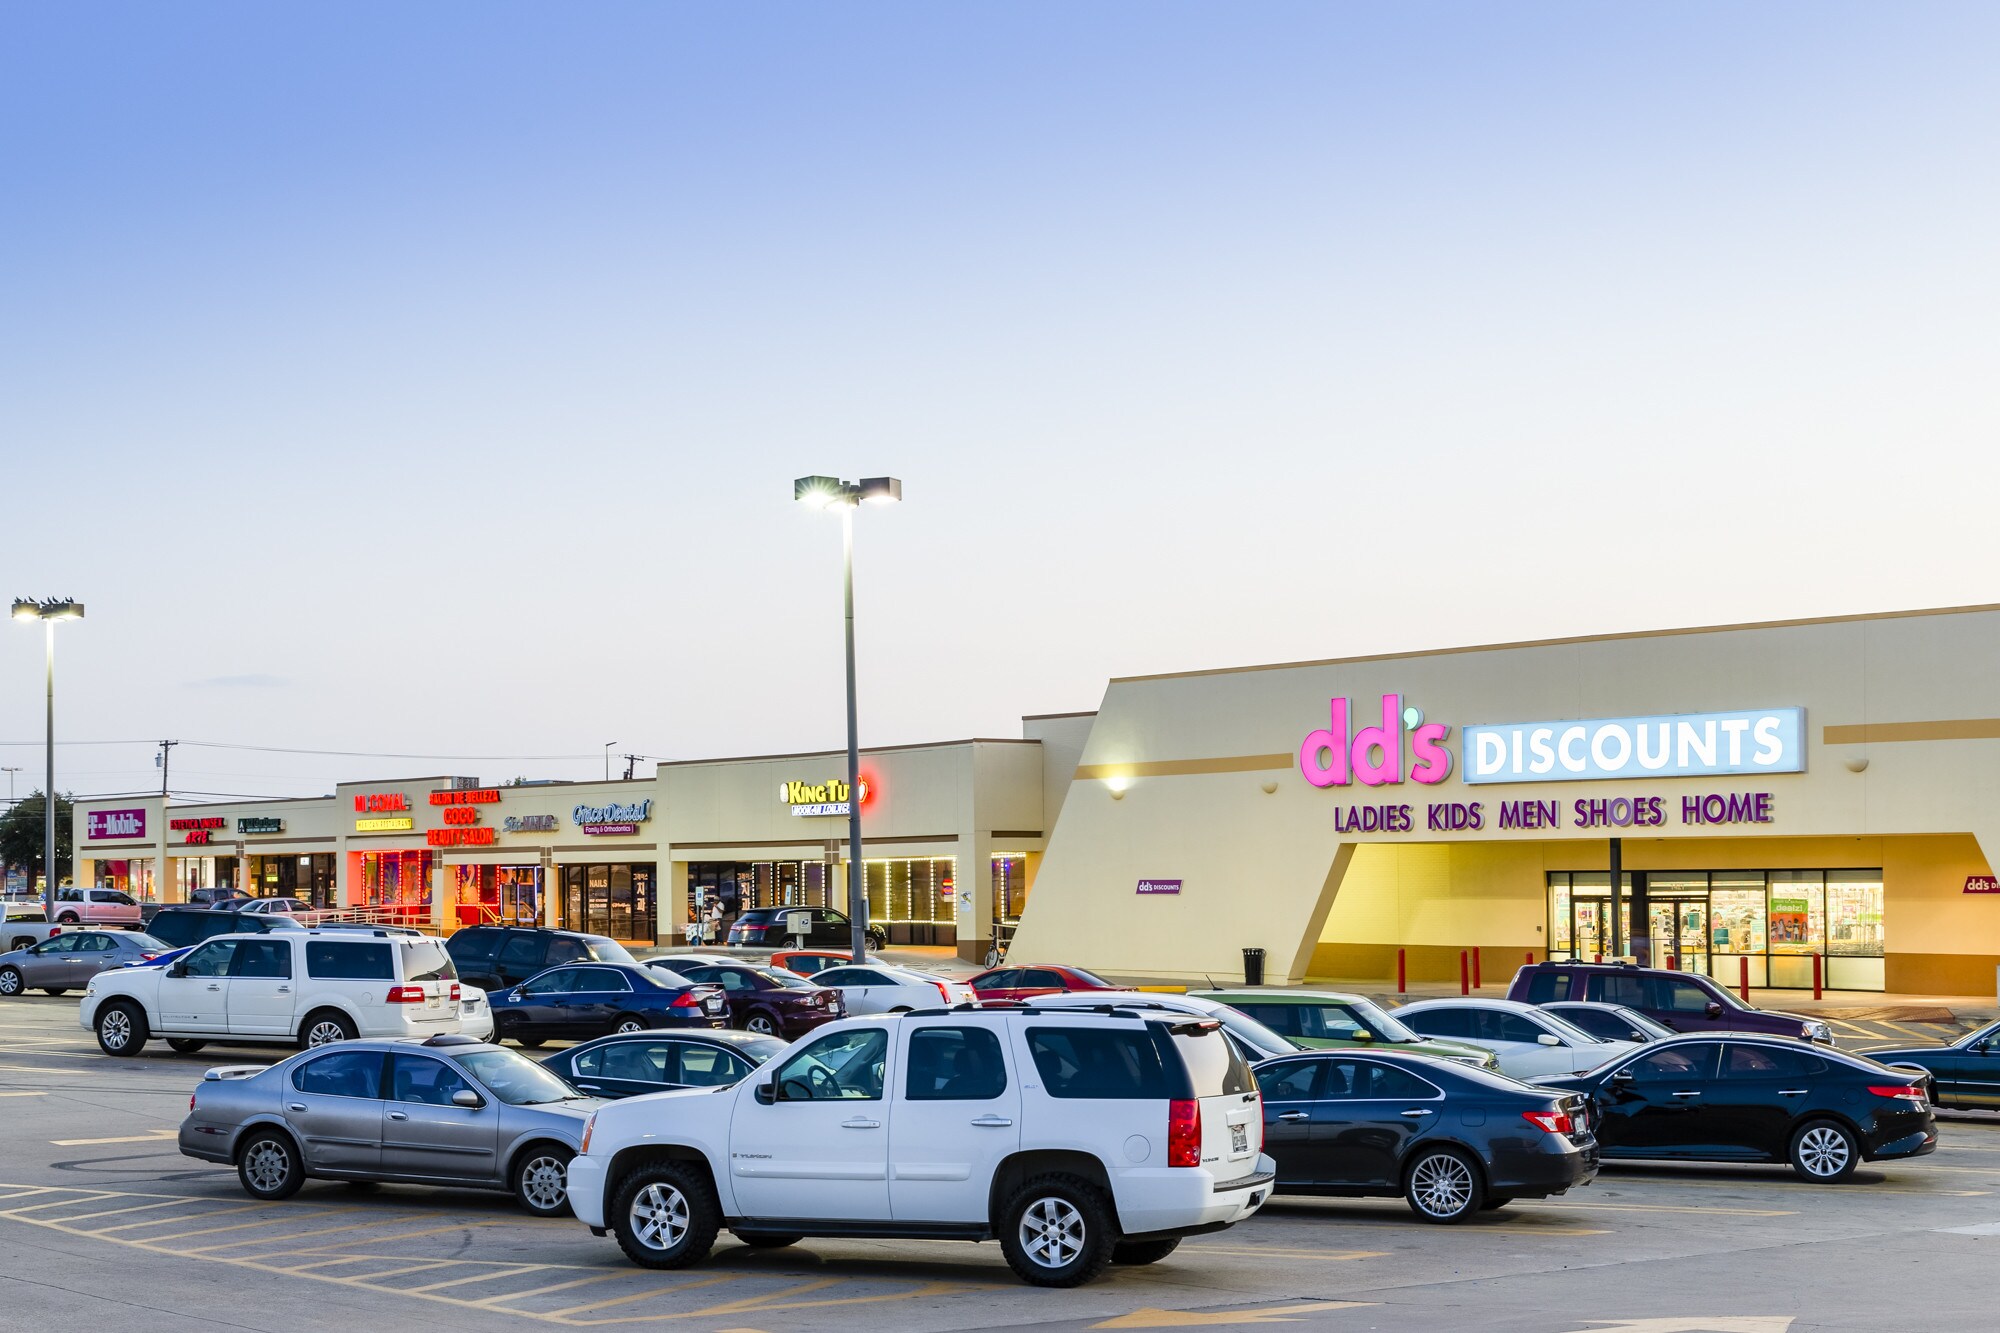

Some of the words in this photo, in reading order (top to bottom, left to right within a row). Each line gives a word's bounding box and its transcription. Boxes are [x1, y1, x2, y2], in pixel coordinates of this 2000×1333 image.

[1300, 693, 1451, 786] dd's
[1476, 715, 1783, 776] DISCOUNTS
[466, 790, 500, 803] BELLEZA
[827, 779, 850, 802] TU
[354, 795, 367, 812] MI
[370, 791, 407, 812] COMAL
[604, 798, 650, 822] Dental
[443, 807, 476, 825] COCO
[1334, 803, 1412, 832] LADIES
[1427, 801, 1483, 830] KIDS
[1498, 799, 1559, 828] MEN
[1574, 796, 1665, 827] SHOES
[1682, 792, 1772, 824] HOME
[427, 828, 461, 846] BEAUTY
[463, 828, 494, 845] SALON
[585, 825, 600, 834] Family
[604, 824, 632, 833] Orthodontics
[589, 878, 608, 888] NAILS
[1139, 881, 1153, 891] dd's
[1967, 878, 1990, 890] dd's
